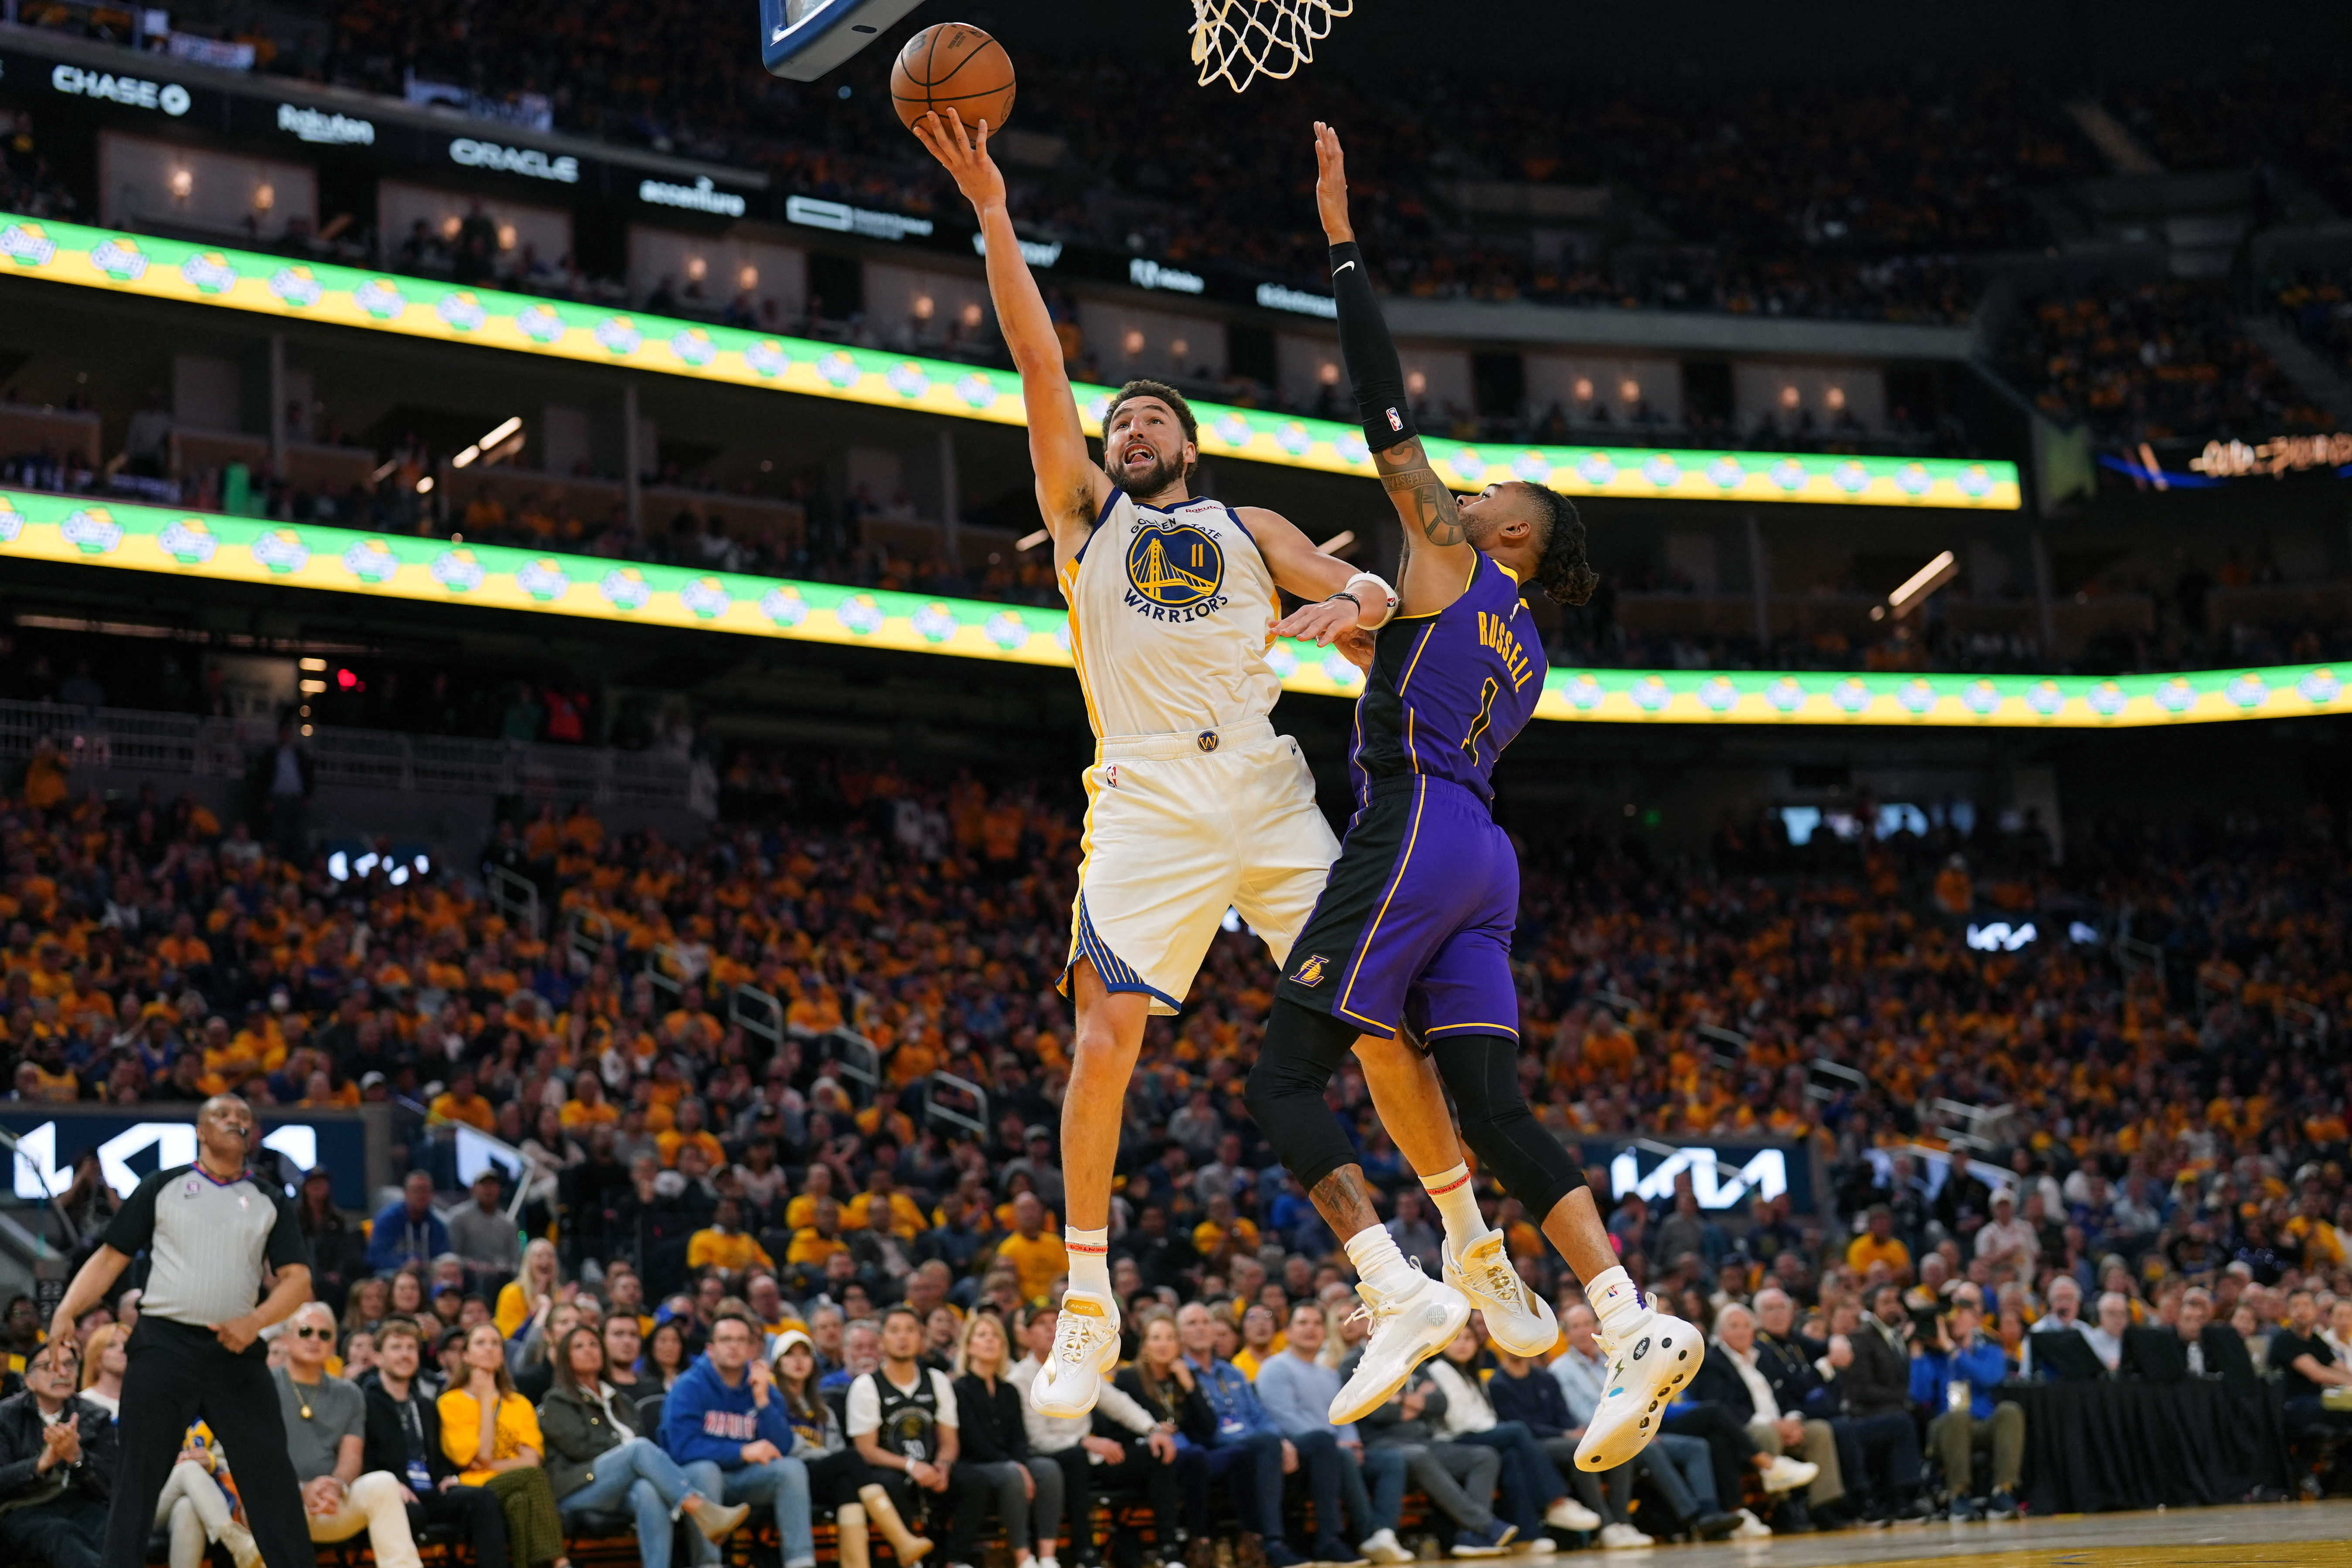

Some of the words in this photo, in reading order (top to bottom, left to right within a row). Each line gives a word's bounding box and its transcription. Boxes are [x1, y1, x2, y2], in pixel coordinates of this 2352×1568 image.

[52, 64, 159, 109] CHASE
[449, 138, 579, 183] ORACLE
[1185, 505, 1225, 514] Rakuten
[1131, 518, 1176, 534] GOLEN
[1191, 523, 1223, 539] TATE
[1191, 543, 1204, 567] 11
[1124, 587, 1228, 623] WARRIORS
[1478, 611, 1533, 693] RUSSELL
[1460, 677, 1499, 767] 1
[1198, 733, 1217, 750] W
[1481, 1244, 1501, 1254] ANTA
